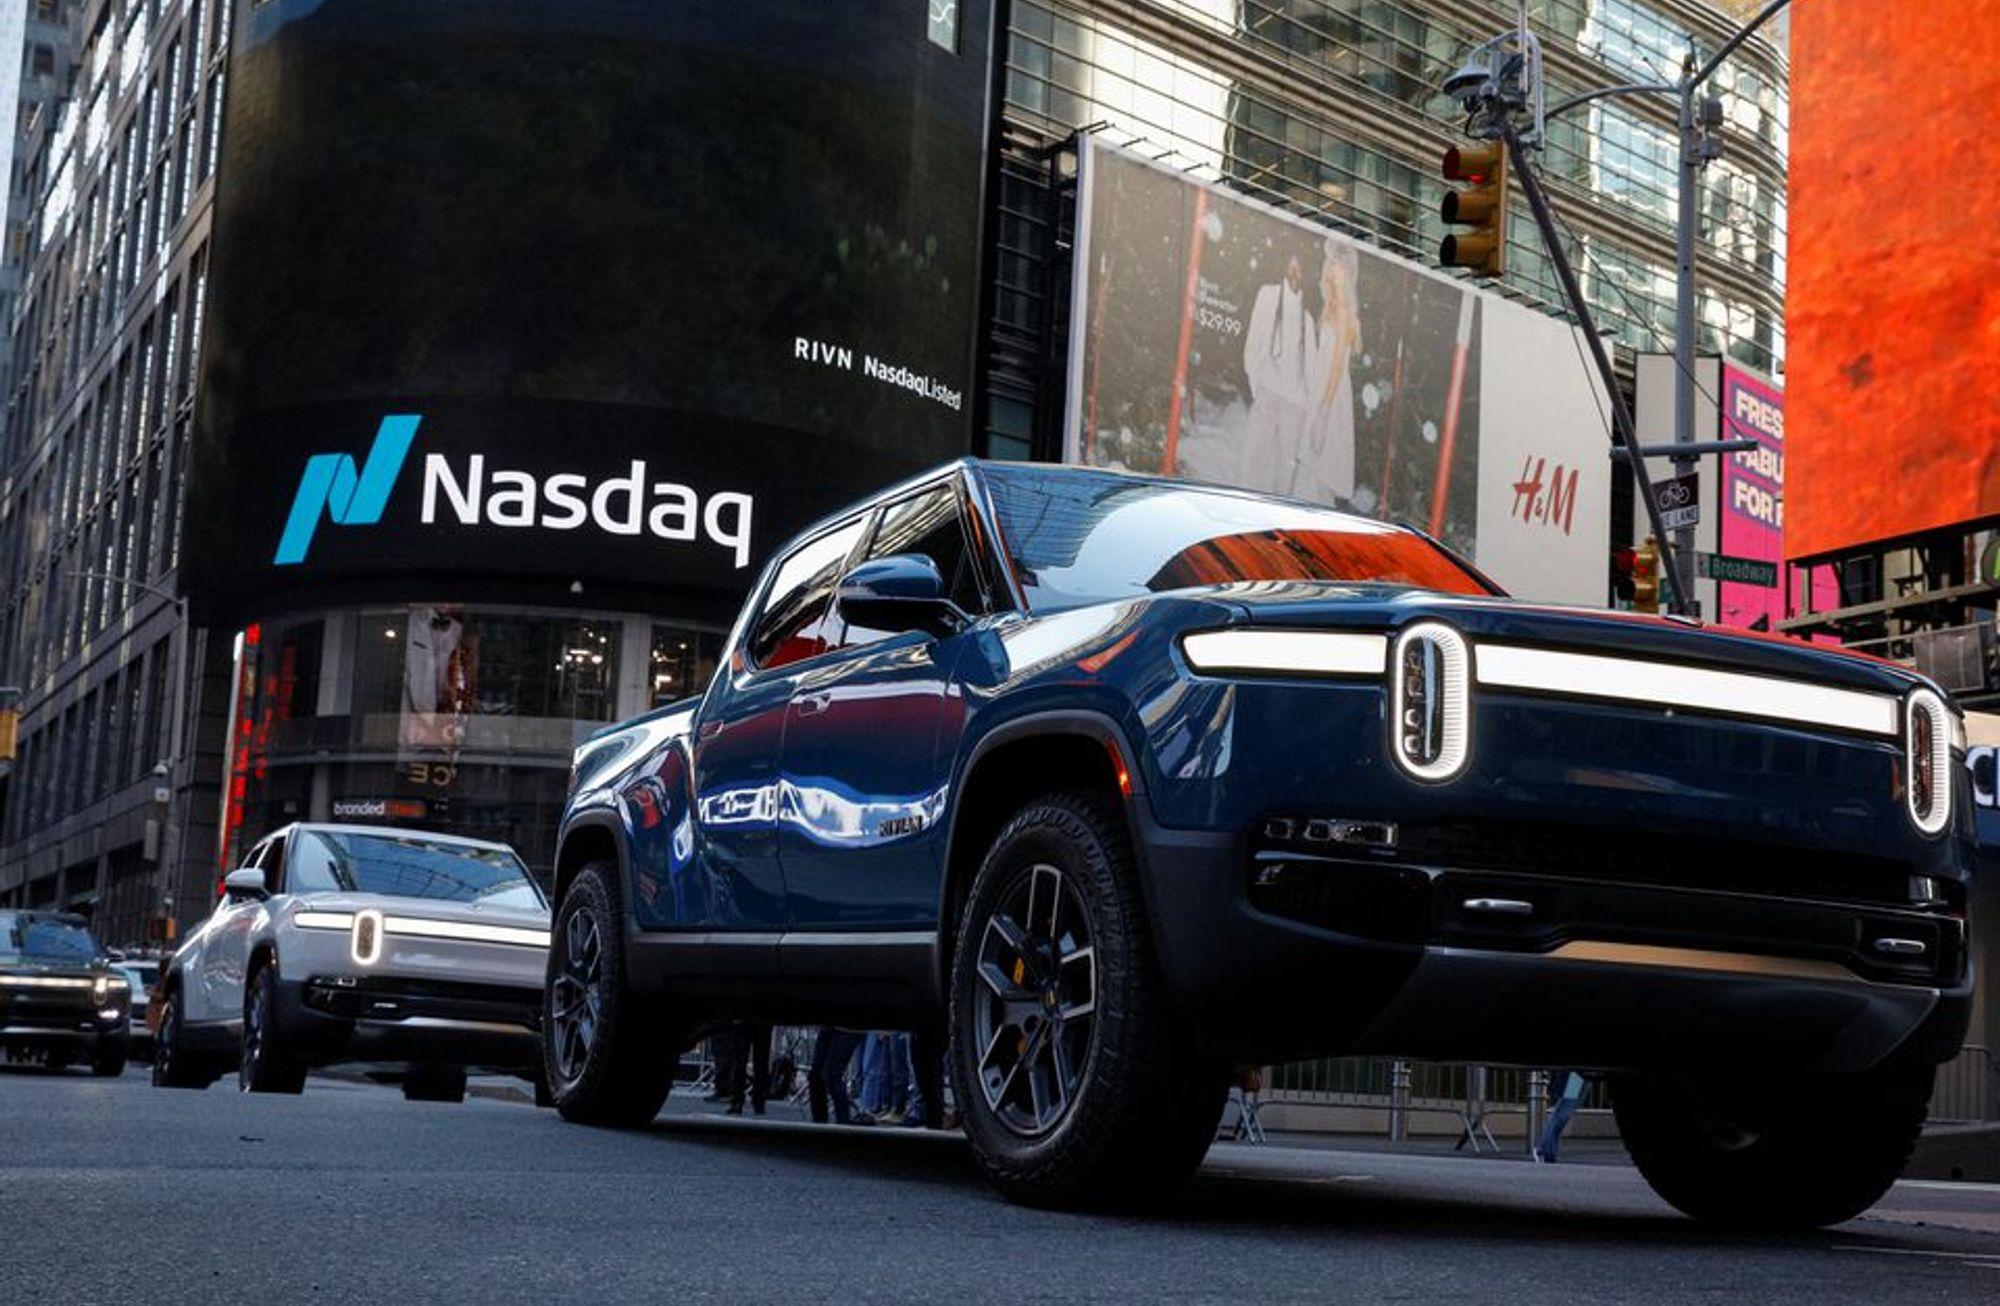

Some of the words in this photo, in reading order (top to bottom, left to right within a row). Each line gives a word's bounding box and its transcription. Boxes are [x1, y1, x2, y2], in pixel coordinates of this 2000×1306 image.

[795, 336, 853, 371] RIVN
[421, 453, 753, 569] Nasdaq
[1511, 454, 1579, 537] H&M
[1734, 479, 1773, 524] FOR
[1712, 557, 1774, 587] Broadway
[333, 802, 385, 816] branded
